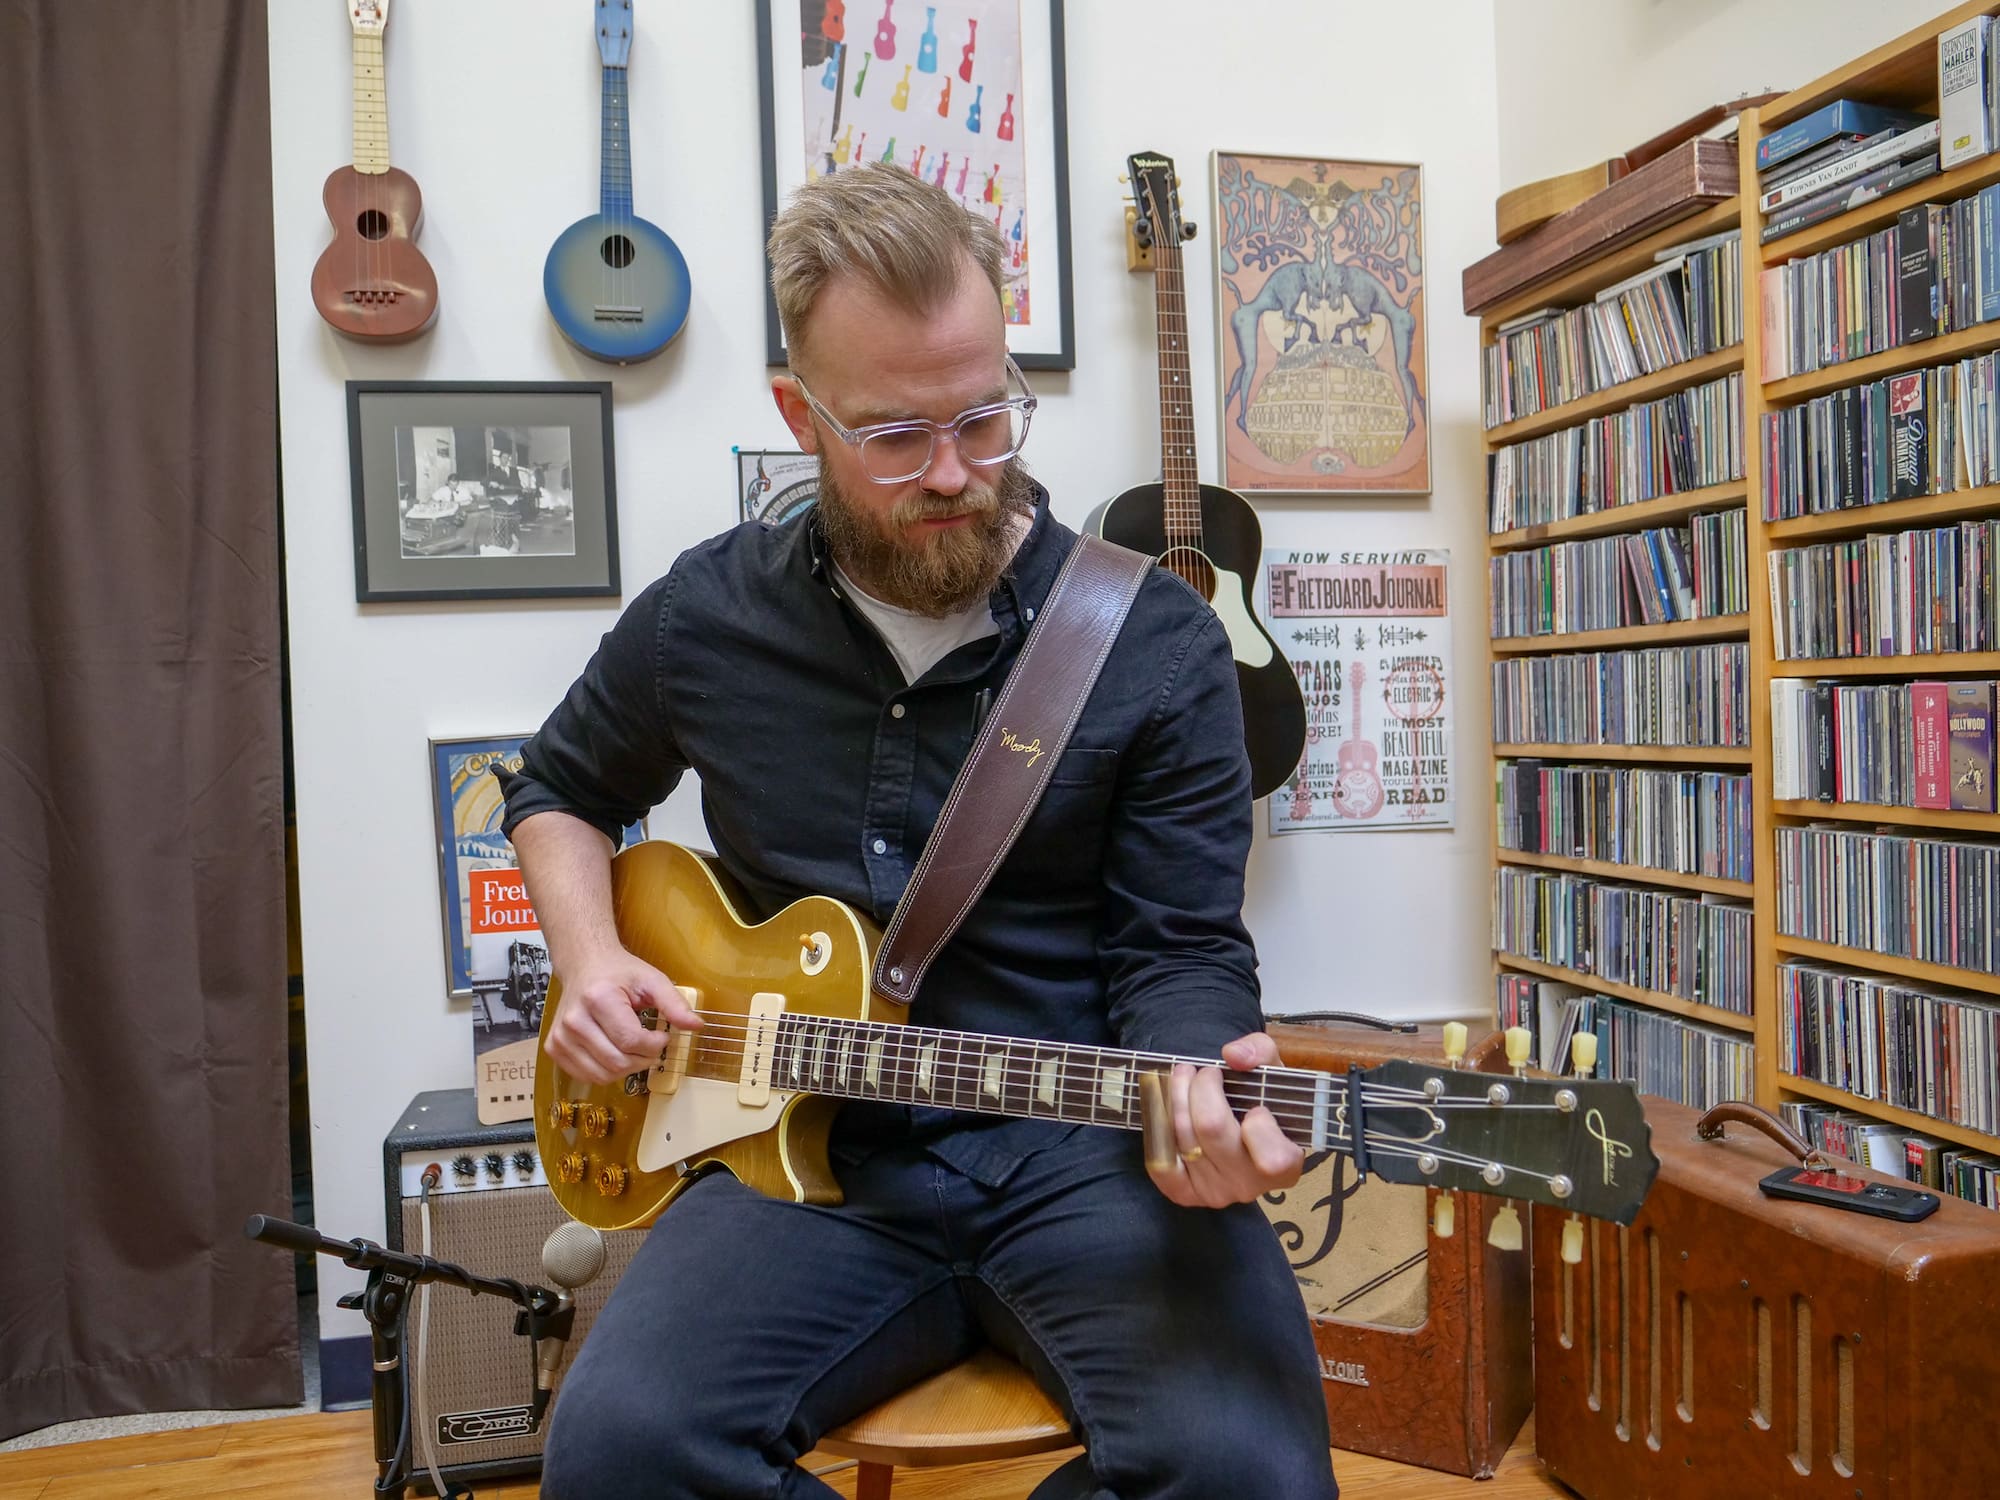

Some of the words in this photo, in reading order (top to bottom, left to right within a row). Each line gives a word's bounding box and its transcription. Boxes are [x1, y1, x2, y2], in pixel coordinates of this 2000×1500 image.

[1944, 46, 1975, 72] MAHLER
[1788, 178, 1817, 196] TOWNES
[1817, 170, 1833, 184] VAN
[1834, 160, 1859, 178] ZANDT
[1763, 225, 1780, 238] WILLIE
[1780, 217, 1801, 231] NELSON
[1896, 427, 1909, 481] REINHARDT
[1906, 415, 1924, 486] Django
[1288, 552, 1330, 564] NOW
[1340, 552, 1426, 564] SERVING
[1271, 570, 1283, 609] THE
[1283, 569, 1372, 610] FRETBOARD
[1372, 569, 1444, 609] JOURNAL
[1290, 659, 1342, 692] ITARS
[1393, 686, 1431, 704] ELECTRIC
[1307, 725, 1342, 738] ORE!
[1383, 718, 1398, 728] THE
[1402, 717, 1445, 729] MOST
[1950, 718, 1986, 731] HOLLYWOOD
[1001, 727, 1045, 768] Moody
[1384, 731, 1448, 757] BEAUTIFUL
[1382, 759, 1448, 777] MAGAZINE
[1415, 777, 1449, 785] EVER
[1281, 791, 1337, 801] YEAR
[1386, 787, 1446, 806] READ
[446, 1408, 530, 1440] CARR
